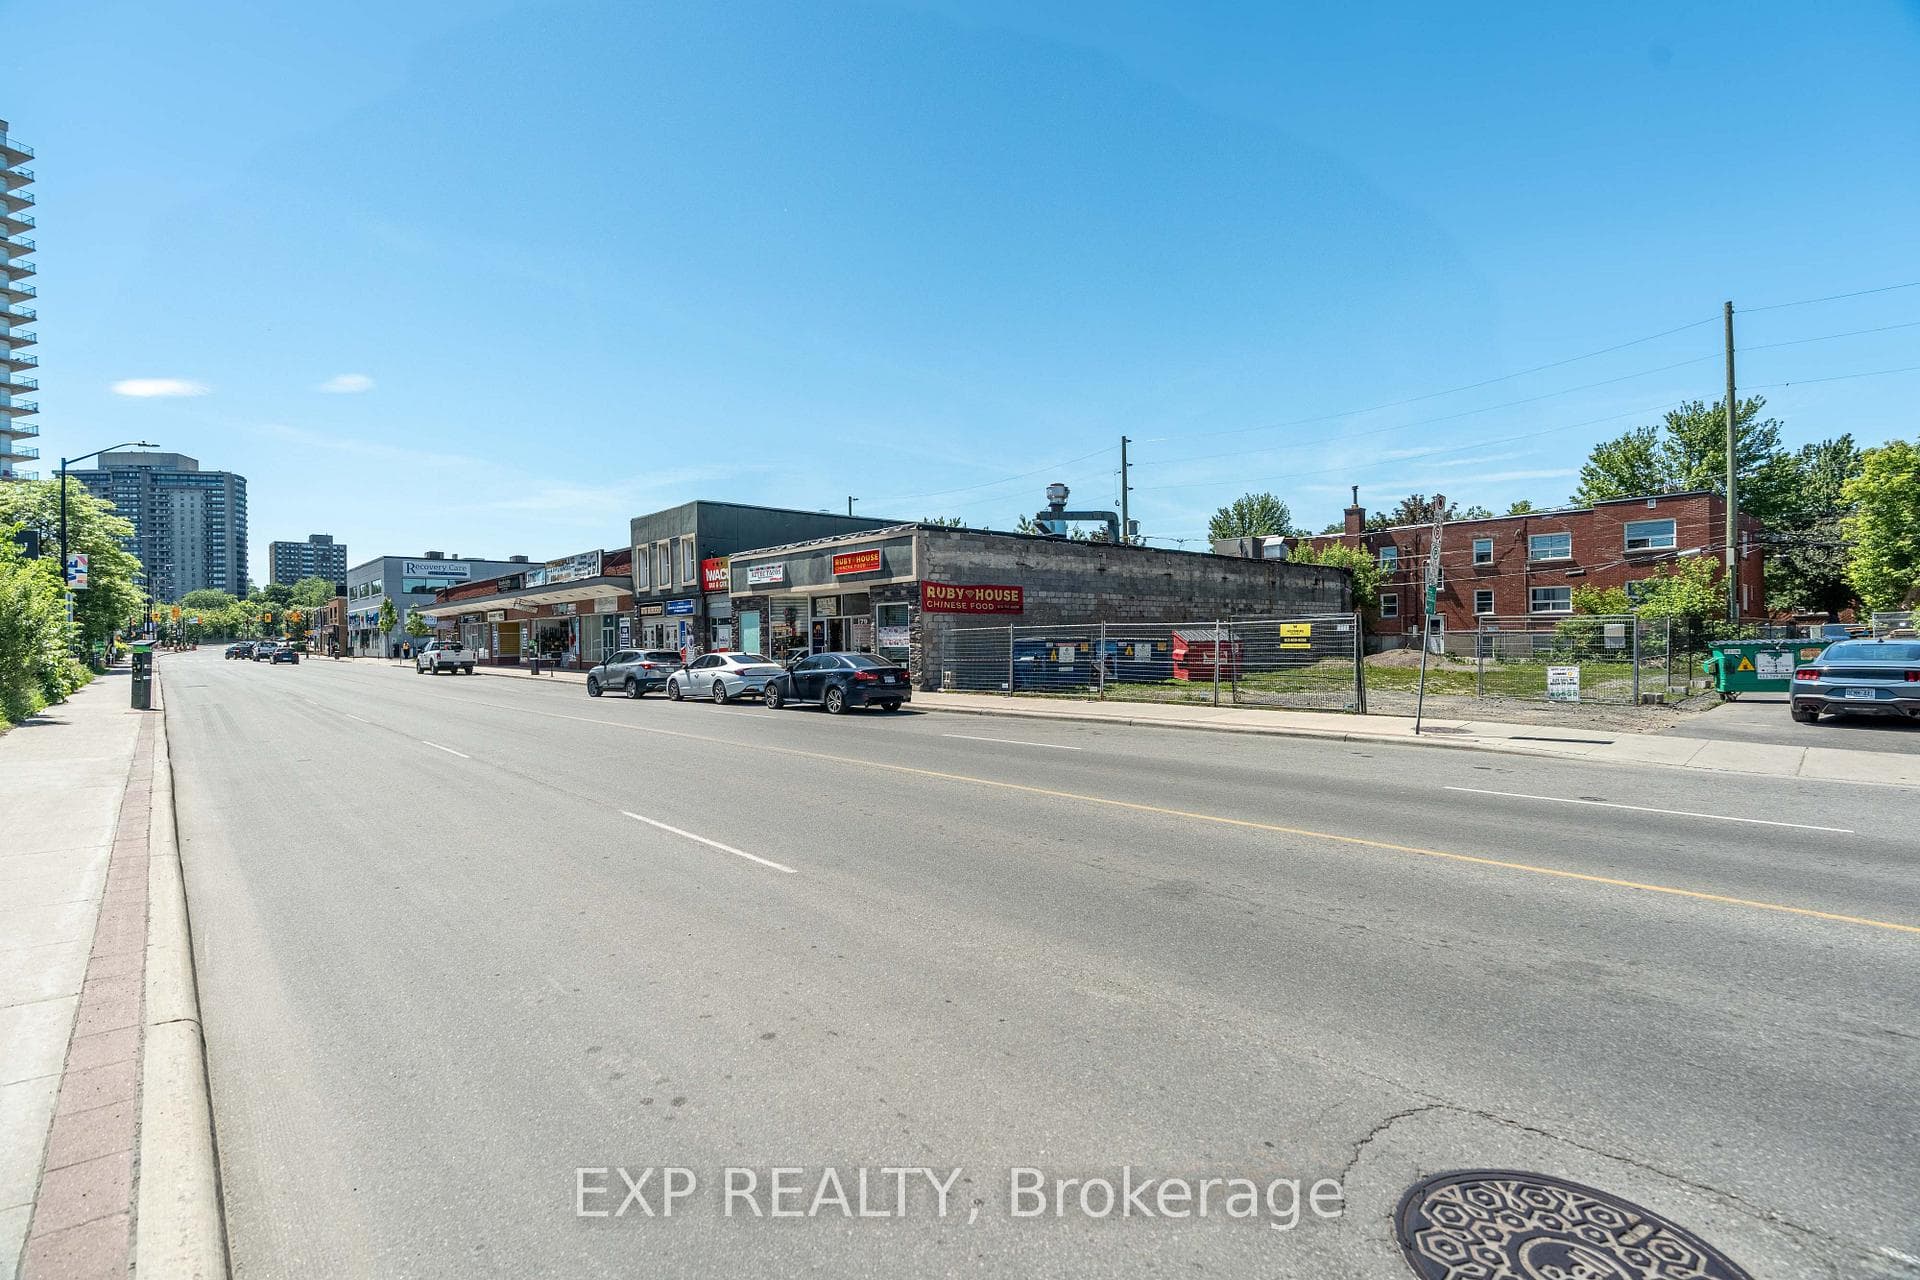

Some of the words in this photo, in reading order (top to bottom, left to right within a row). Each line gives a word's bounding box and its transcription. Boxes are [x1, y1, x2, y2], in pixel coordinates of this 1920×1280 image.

[834, 558, 851, 566] RUBY
[856, 553, 879, 563] HOUSE
[406, 562, 447, 574] Recovery
[448, 564, 468, 572] Care
[705, 568, 729, 582] MAC
[926, 586, 964, 600] RUBY
[975, 589, 1019, 602] HOUSE
[926, 600, 968, 610] CHINESE
[970, 602, 995, 610] FOOD
